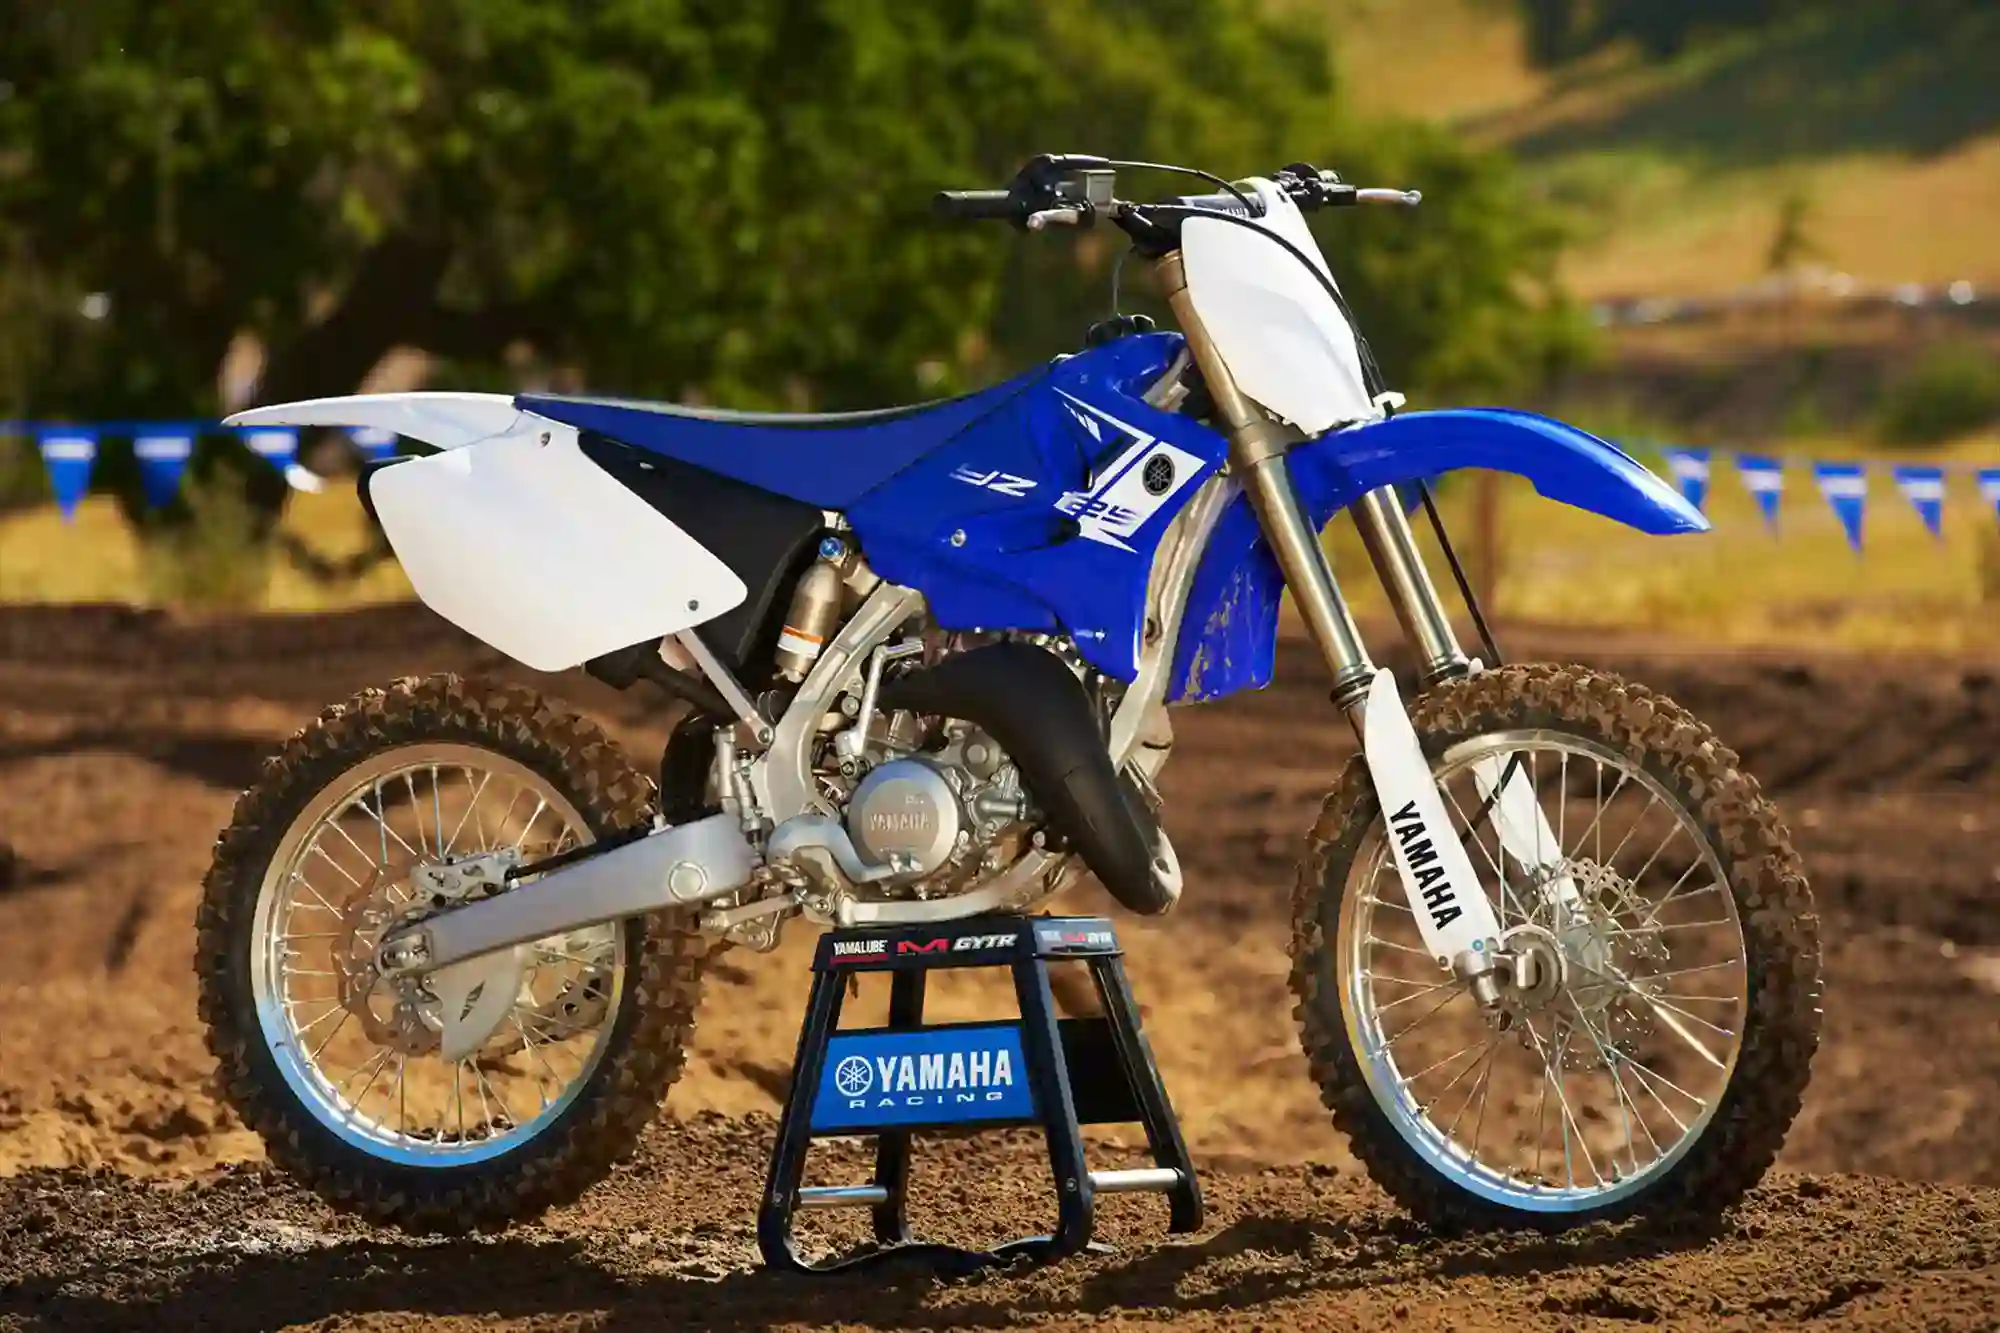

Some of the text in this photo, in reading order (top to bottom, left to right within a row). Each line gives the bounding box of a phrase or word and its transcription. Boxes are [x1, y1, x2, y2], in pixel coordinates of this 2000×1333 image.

[870, 811, 931, 832] YAMAHA
[1390, 800, 1463, 930] YAMAHA
[833, 939, 888, 956] YAMALUBE
[953, 934, 1018, 950] GYTR
[876, 1049, 1012, 1092] YAMAHA
[849, 1092, 1003, 1109] RACING
